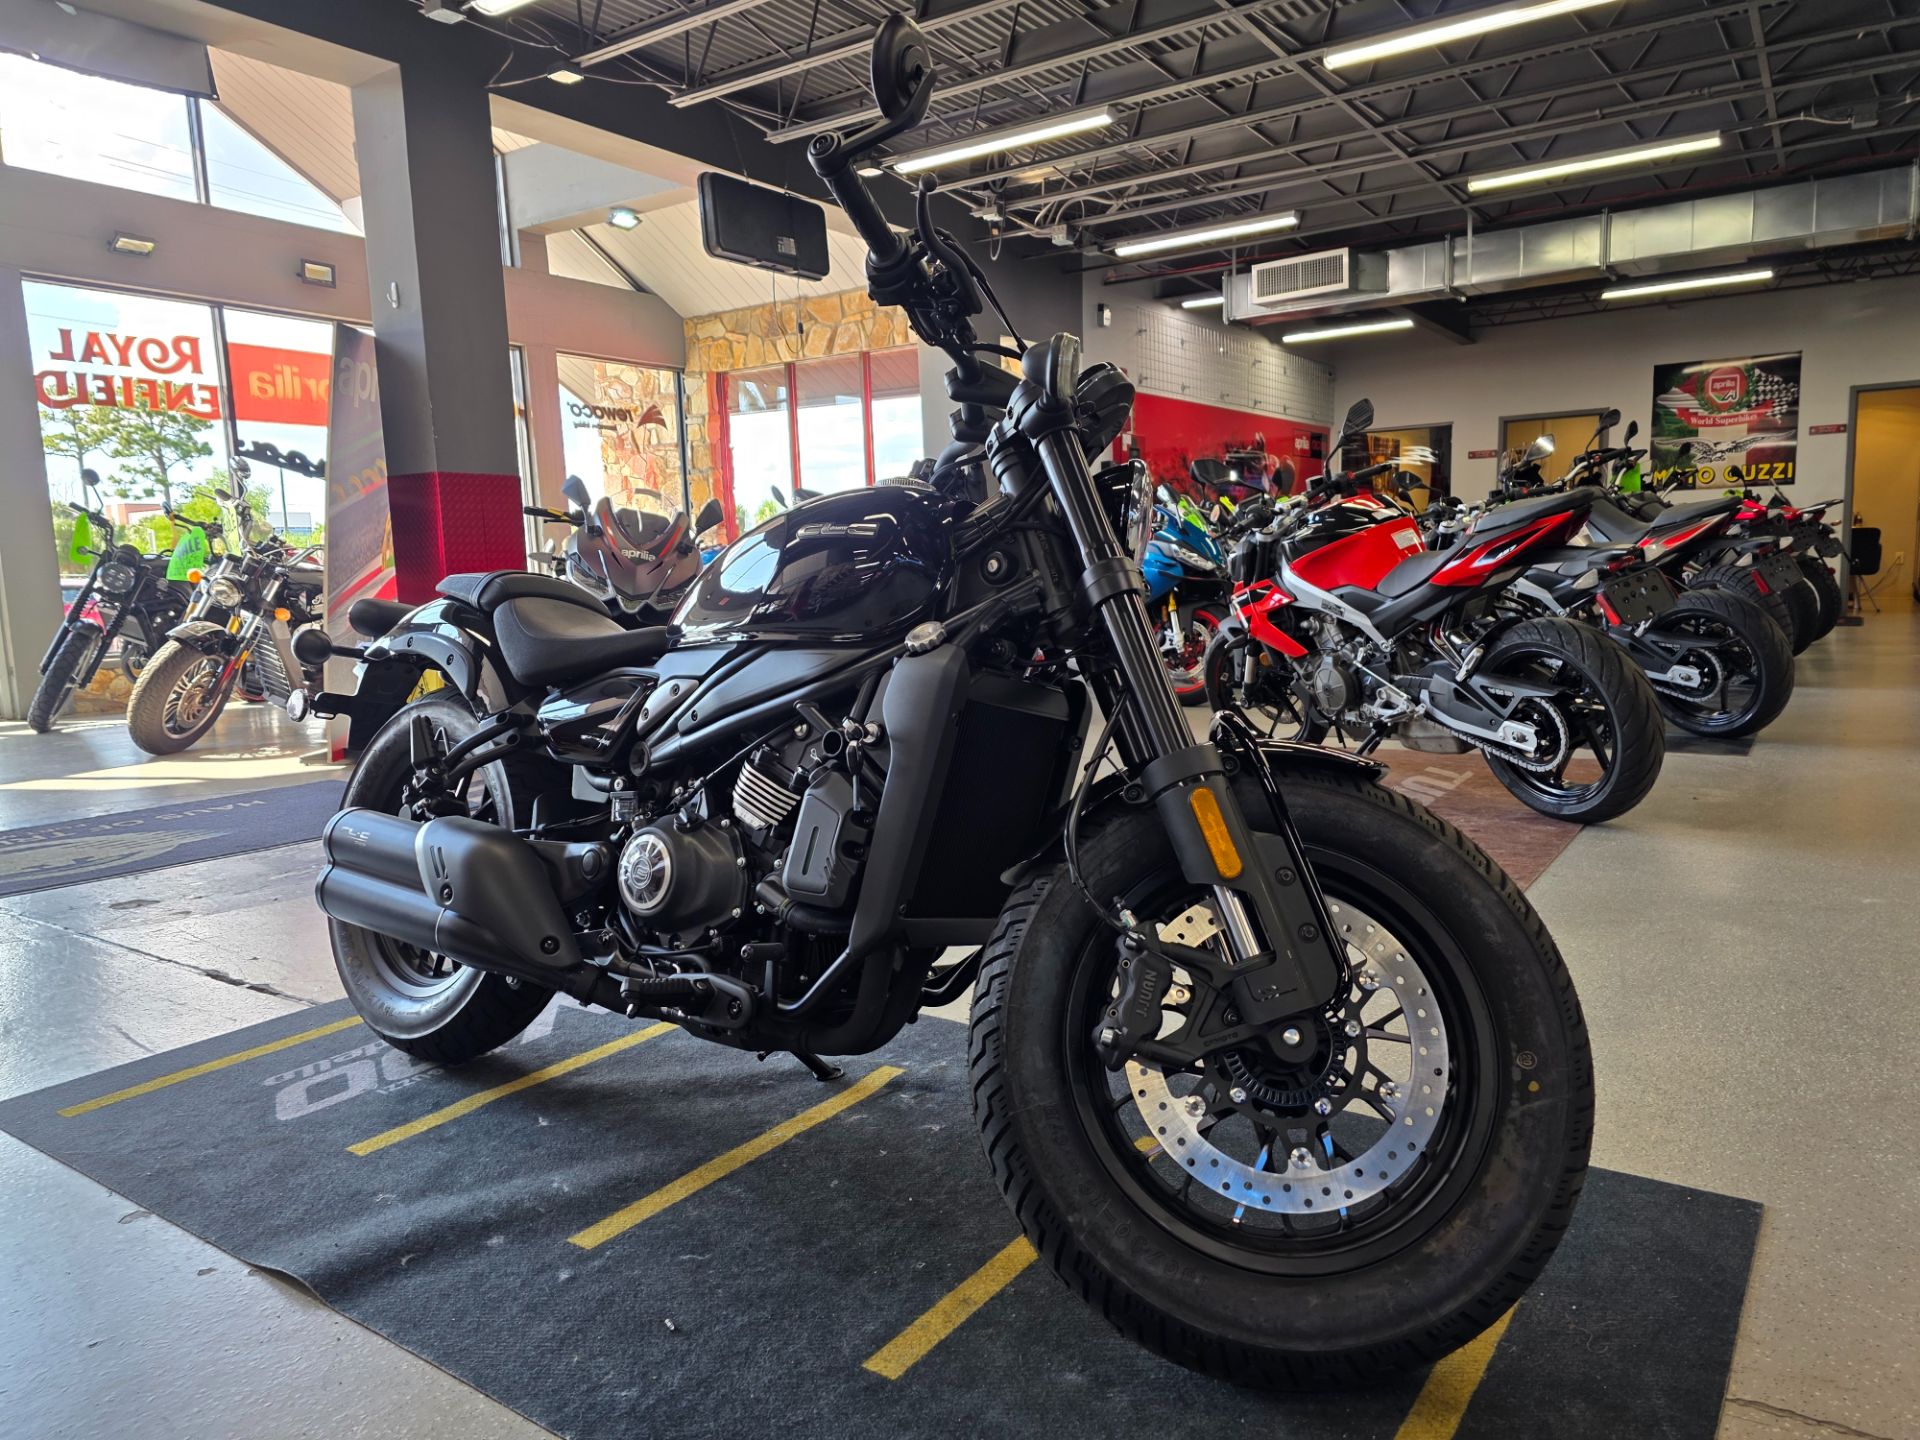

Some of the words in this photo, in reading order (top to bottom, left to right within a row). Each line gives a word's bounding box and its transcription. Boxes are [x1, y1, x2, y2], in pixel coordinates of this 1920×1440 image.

[1690, 415, 1713, 426] World
[1715, 413, 1758, 426] Superbikes
[1653, 467, 1715, 485] MTO
[621, 549, 656, 562] aprilia
[154, 799, 266, 821] HAUS
[96, 818, 145, 830] OF
[1135, 969, 1157, 1018] J.JUAN
